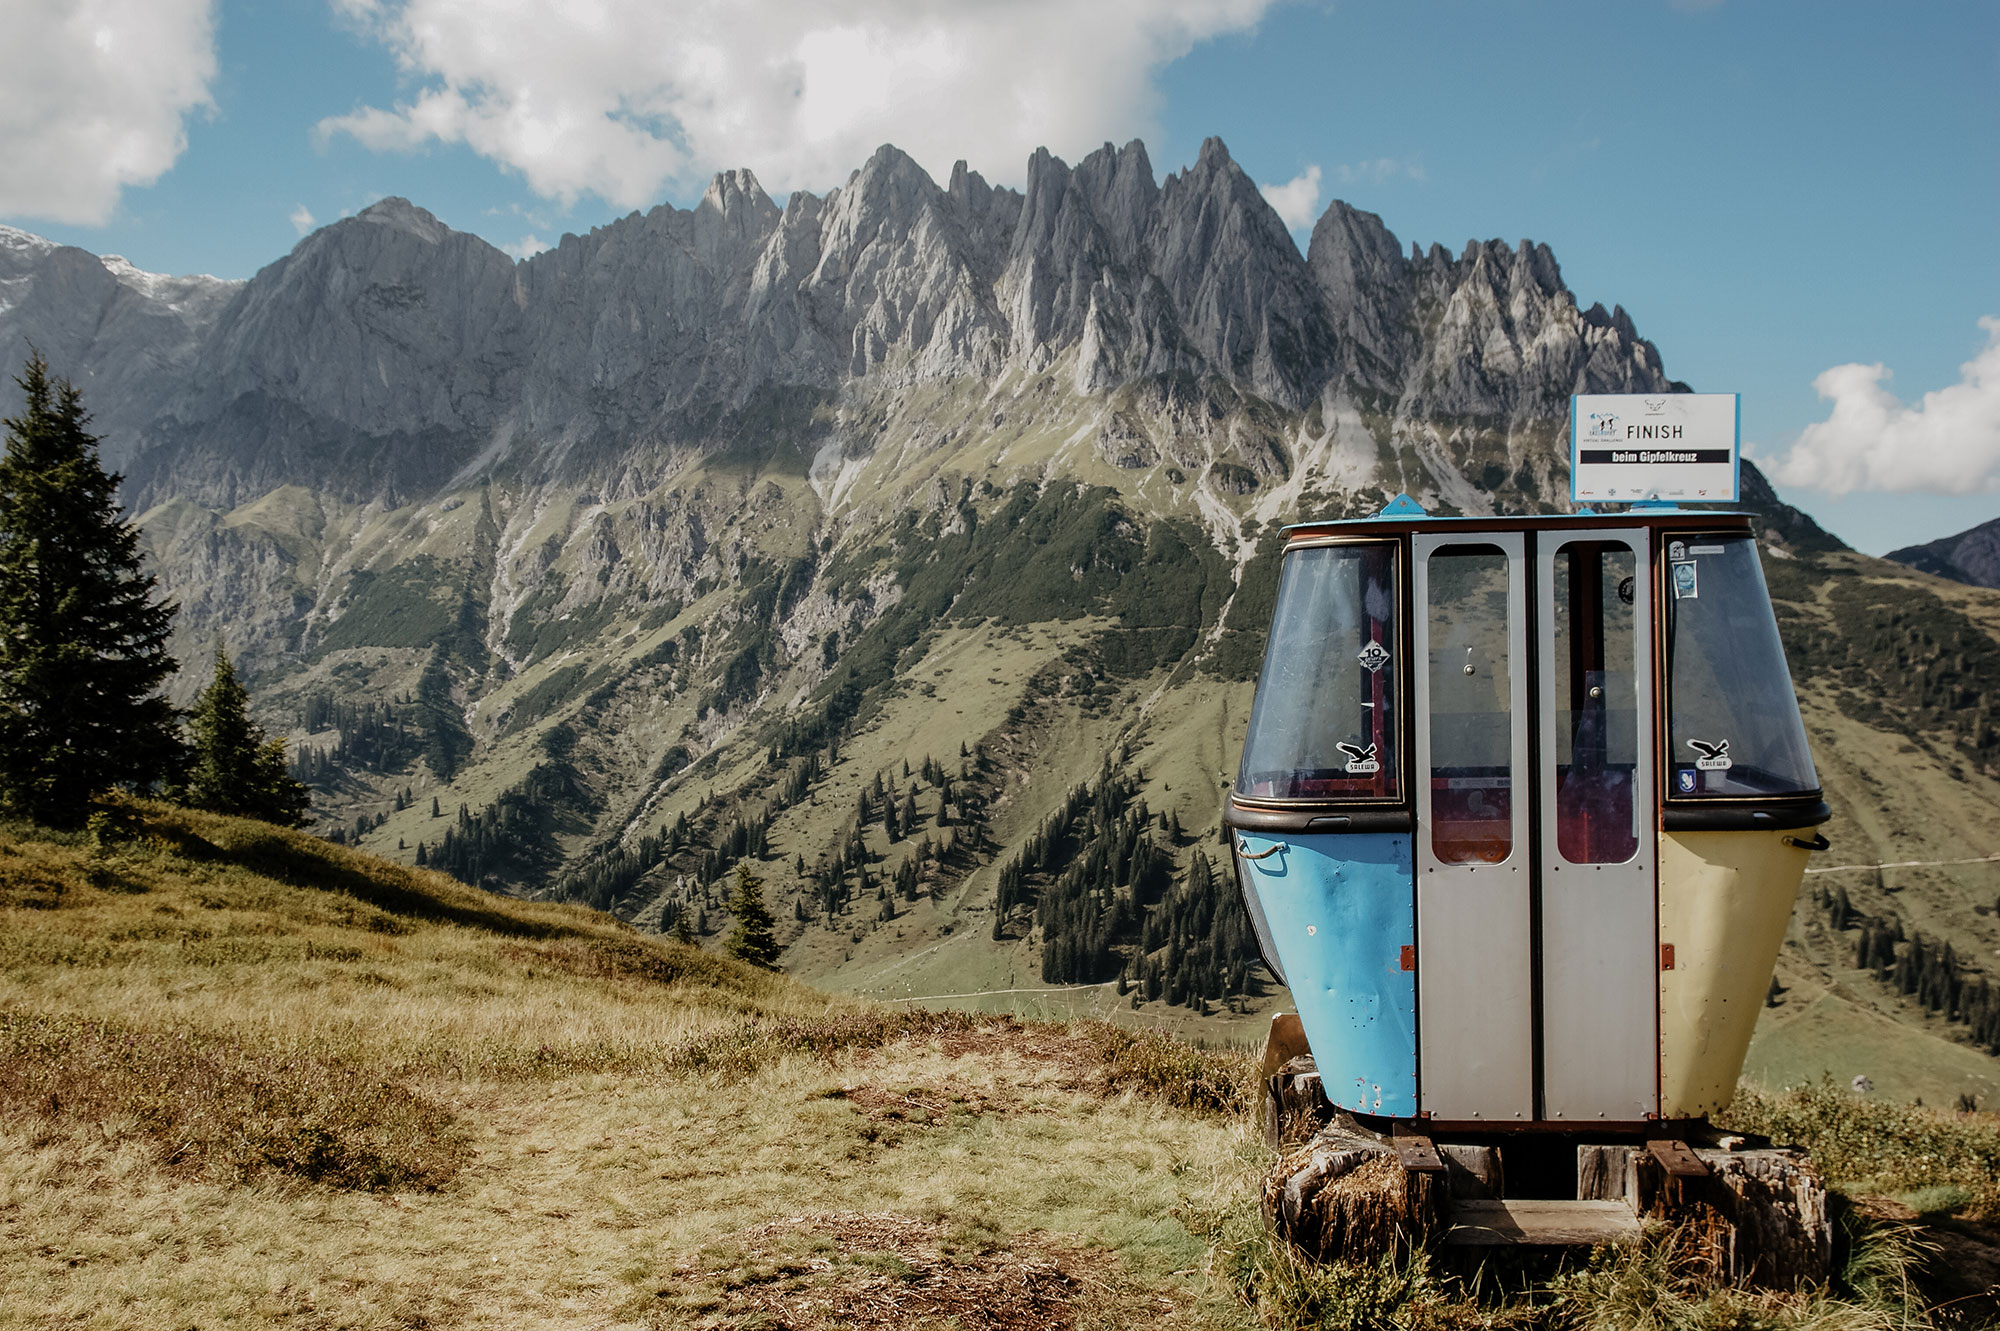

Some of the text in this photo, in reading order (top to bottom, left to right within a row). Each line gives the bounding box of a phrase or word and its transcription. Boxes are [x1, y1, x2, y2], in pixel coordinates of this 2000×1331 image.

[1627, 425, 1683, 439] FINISH
[1612, 451, 1697, 464] beim Gipfelkreuz
[1365, 649, 1381, 658] 10
